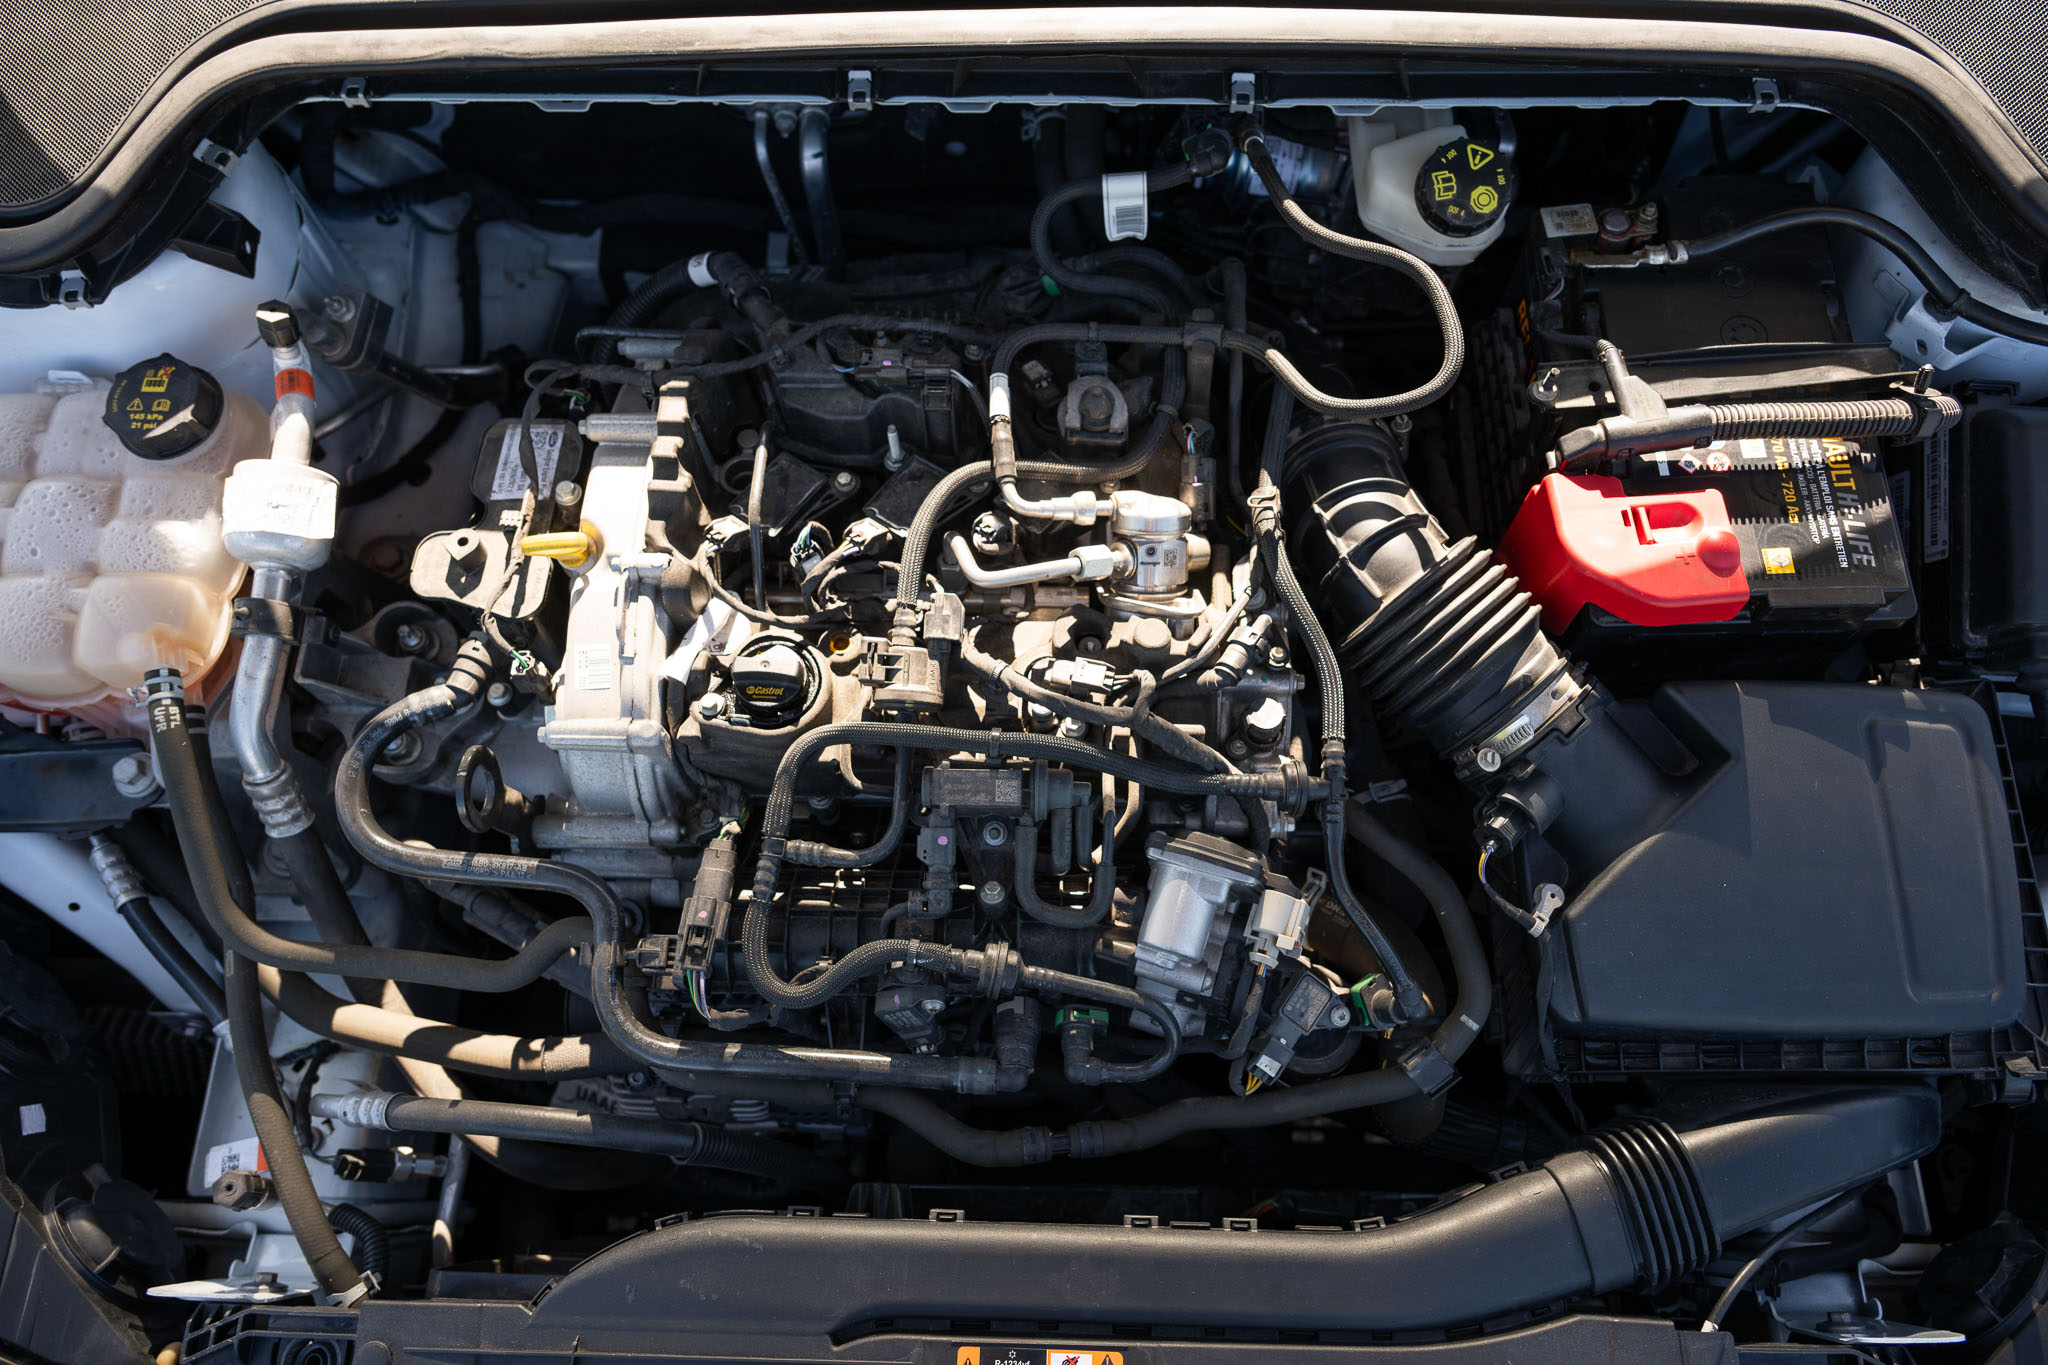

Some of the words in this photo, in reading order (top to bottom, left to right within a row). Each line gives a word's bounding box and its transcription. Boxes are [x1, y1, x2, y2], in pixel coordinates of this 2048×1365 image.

[1446, 148, 1457, 160] 100
[130, 421, 142, 429] 21
[143, 421, 157, 430] psi
[1822, 437, 1856, 490] AULT
[1781, 481, 1796, 502] 720
[1825, 505, 1838, 525] SANS
[1830, 526, 1848, 568] ENTRETIEN
[754, 686, 784, 696] Castrol
[168, 706, 181, 729] BTL
